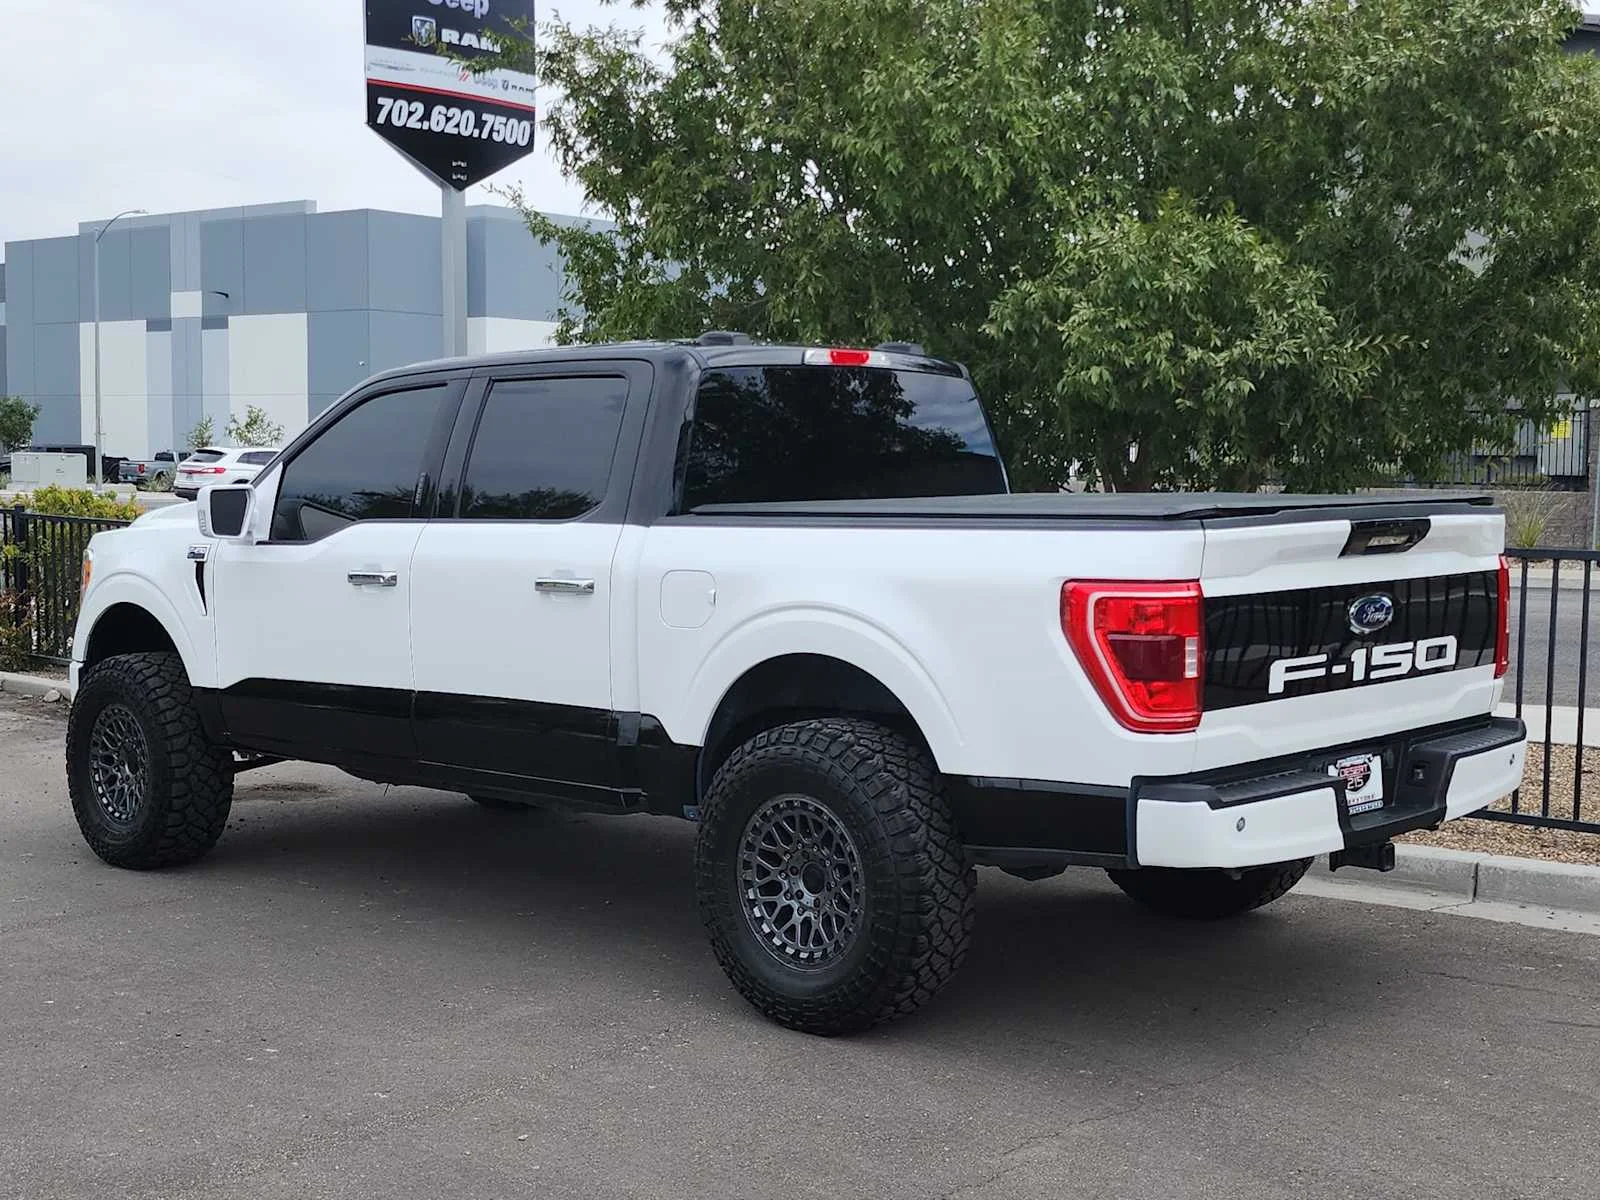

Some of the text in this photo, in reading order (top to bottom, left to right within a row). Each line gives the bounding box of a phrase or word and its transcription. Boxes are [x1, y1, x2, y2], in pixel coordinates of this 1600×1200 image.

[427, 0, 490, 19] eep
[376, 97, 531, 147] 702.620.7500
[1268, 635, 1457, 694] F-150
[1339, 764, 1368, 778] DESERT
